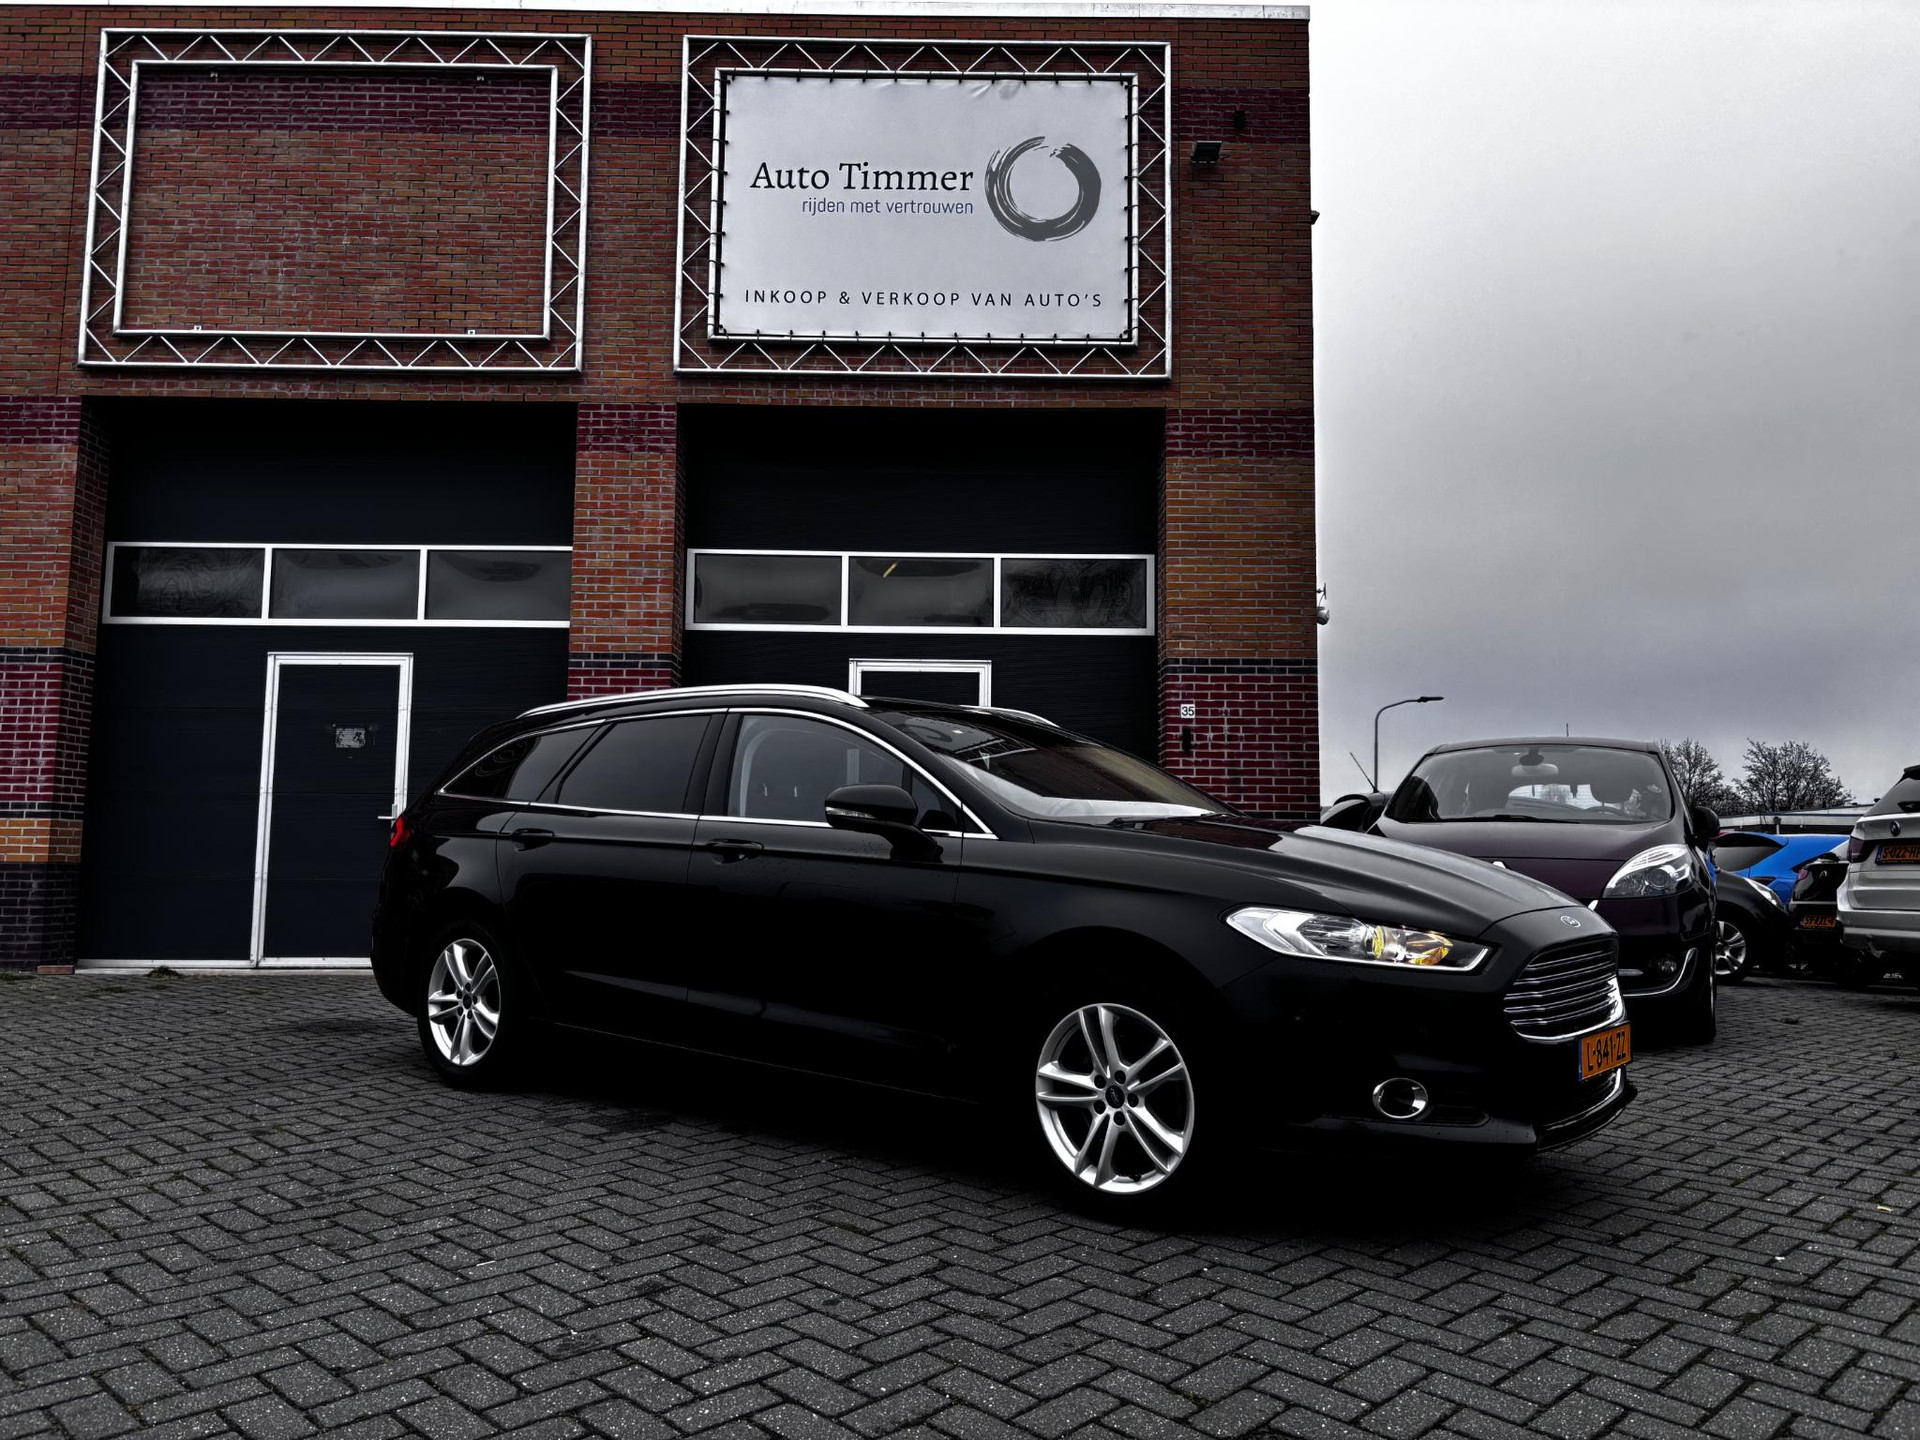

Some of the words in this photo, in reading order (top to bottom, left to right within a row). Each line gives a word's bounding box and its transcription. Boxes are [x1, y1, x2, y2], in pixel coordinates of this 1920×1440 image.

[749, 161, 830, 190] Auto
[838, 161, 974, 191] Timmer
[801, 197, 845, 216] rijden
[850, 199, 881, 214] met
[886, 199, 974, 215] vertrouwen
[744, 289, 827, 304] INKOOP
[838, 291, 851, 305] &
[861, 291, 960, 306] VERKOOP
[971, 292, 1012, 307] VAN
[1024, 293, 1102, 308] AUTO'S
[1181, 705, 1195, 717] 35
